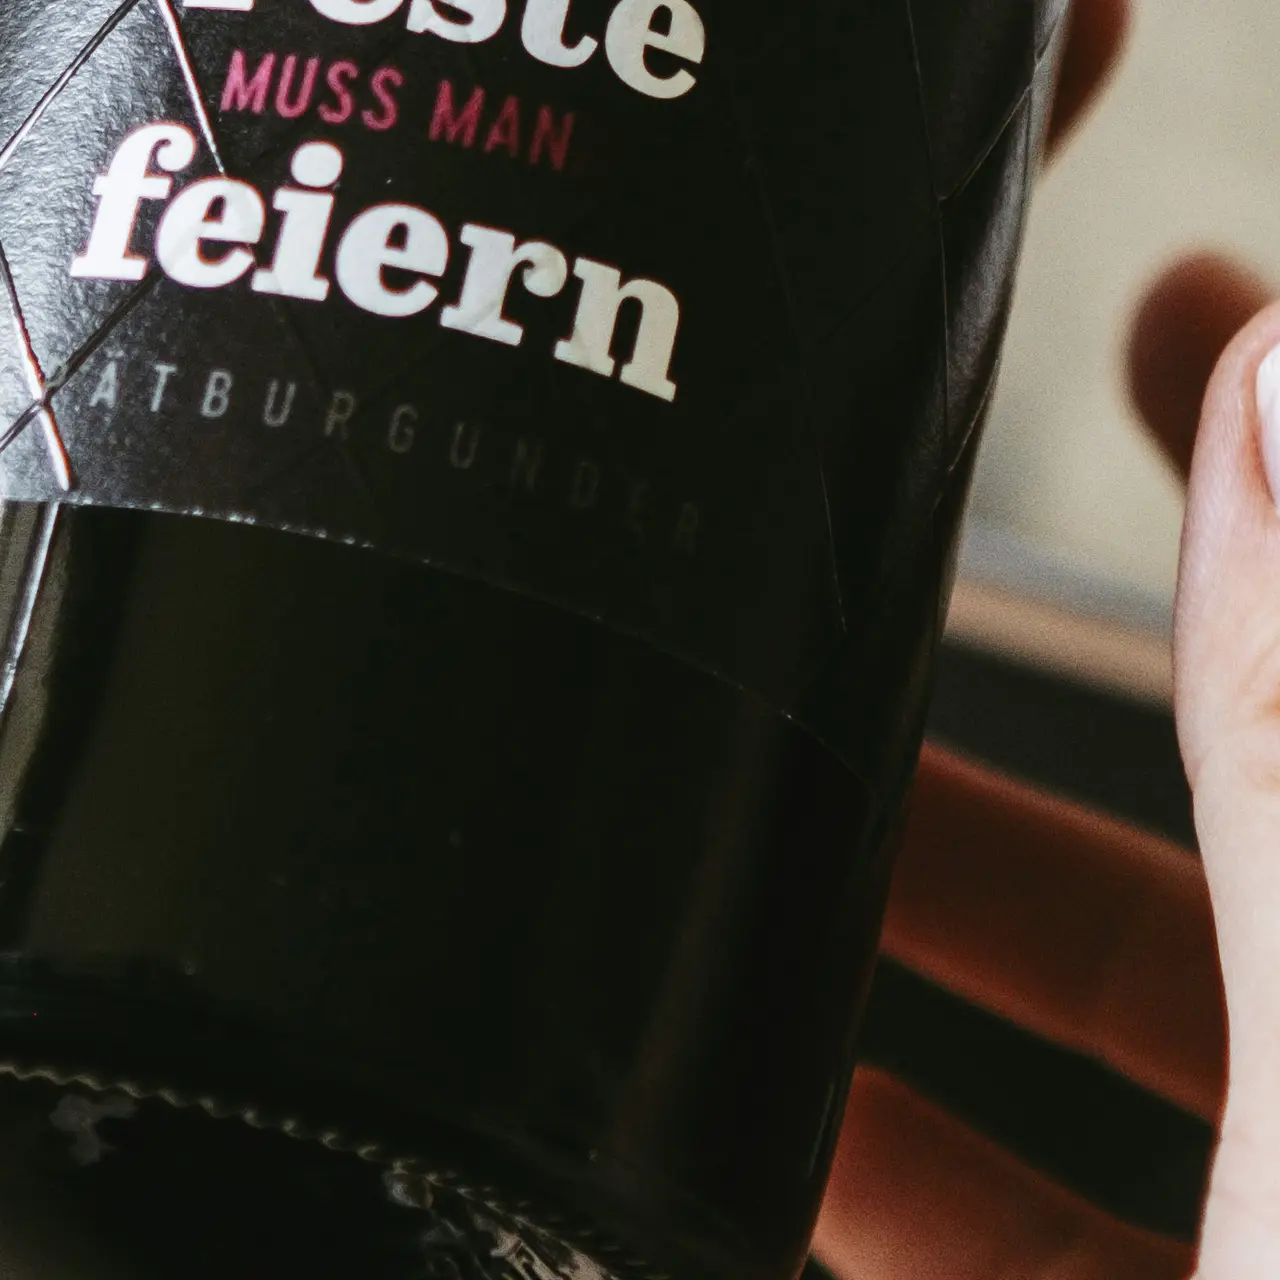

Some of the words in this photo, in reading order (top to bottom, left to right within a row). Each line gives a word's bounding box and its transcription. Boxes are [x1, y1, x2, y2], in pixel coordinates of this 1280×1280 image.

[220, 46, 406, 133] MUSS
[428, 78, 576, 172] MAN
[70, 121, 681, 403] feiern
[86, 346, 704, 554] ÄTBURGUNDER
